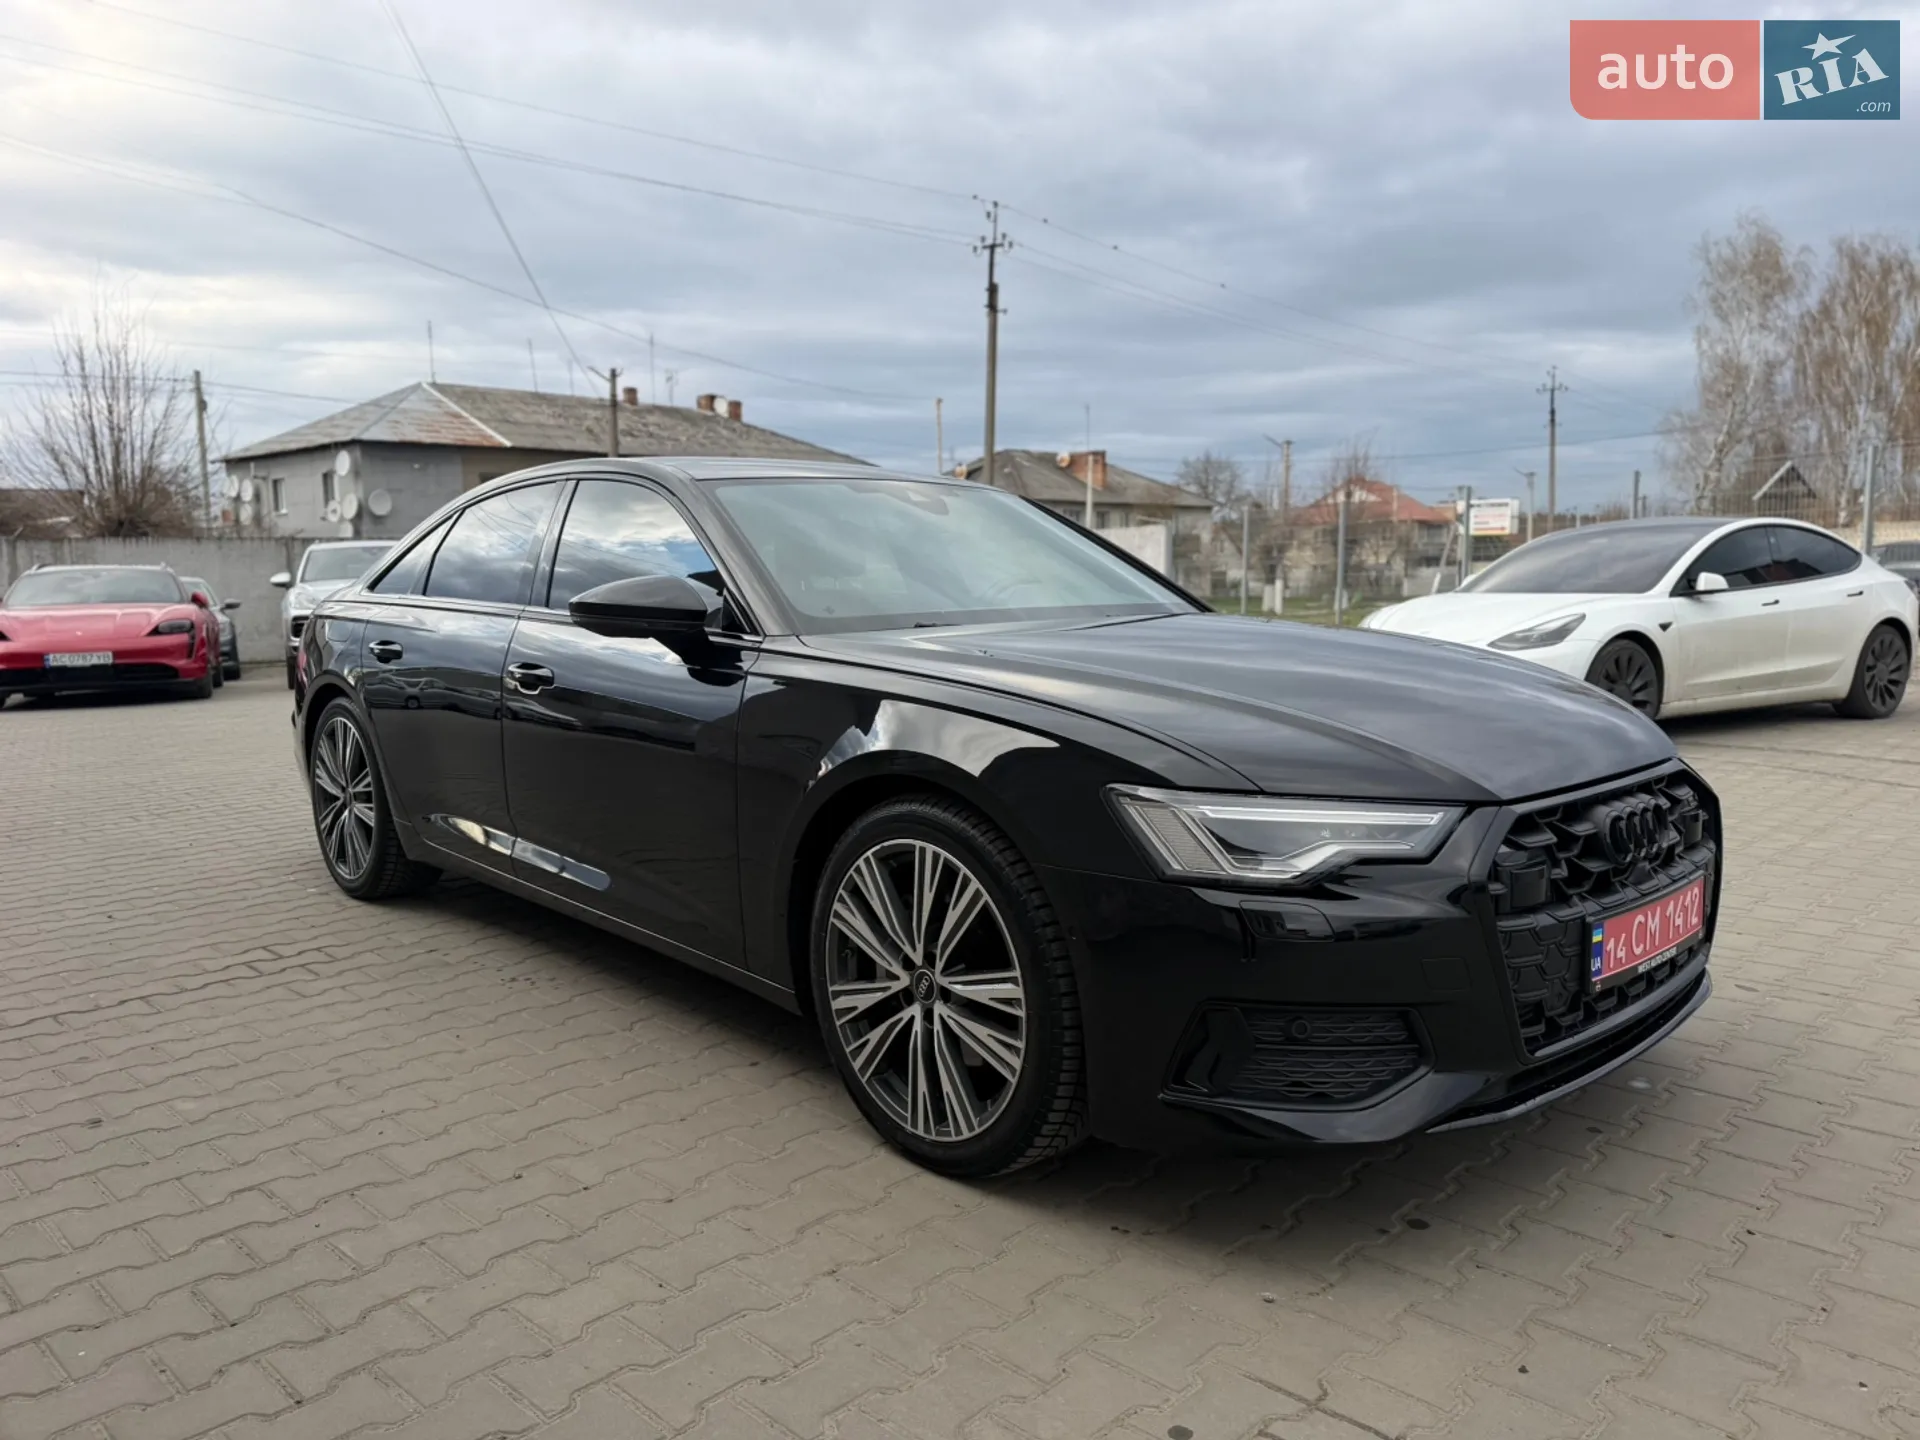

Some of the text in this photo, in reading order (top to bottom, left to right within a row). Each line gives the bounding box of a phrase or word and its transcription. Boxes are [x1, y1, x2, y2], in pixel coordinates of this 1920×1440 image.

[52, 654, 66, 664] AC
[1606, 887, 1700, 969] 14 CM 1412
[1591, 956, 1601, 971] UA
